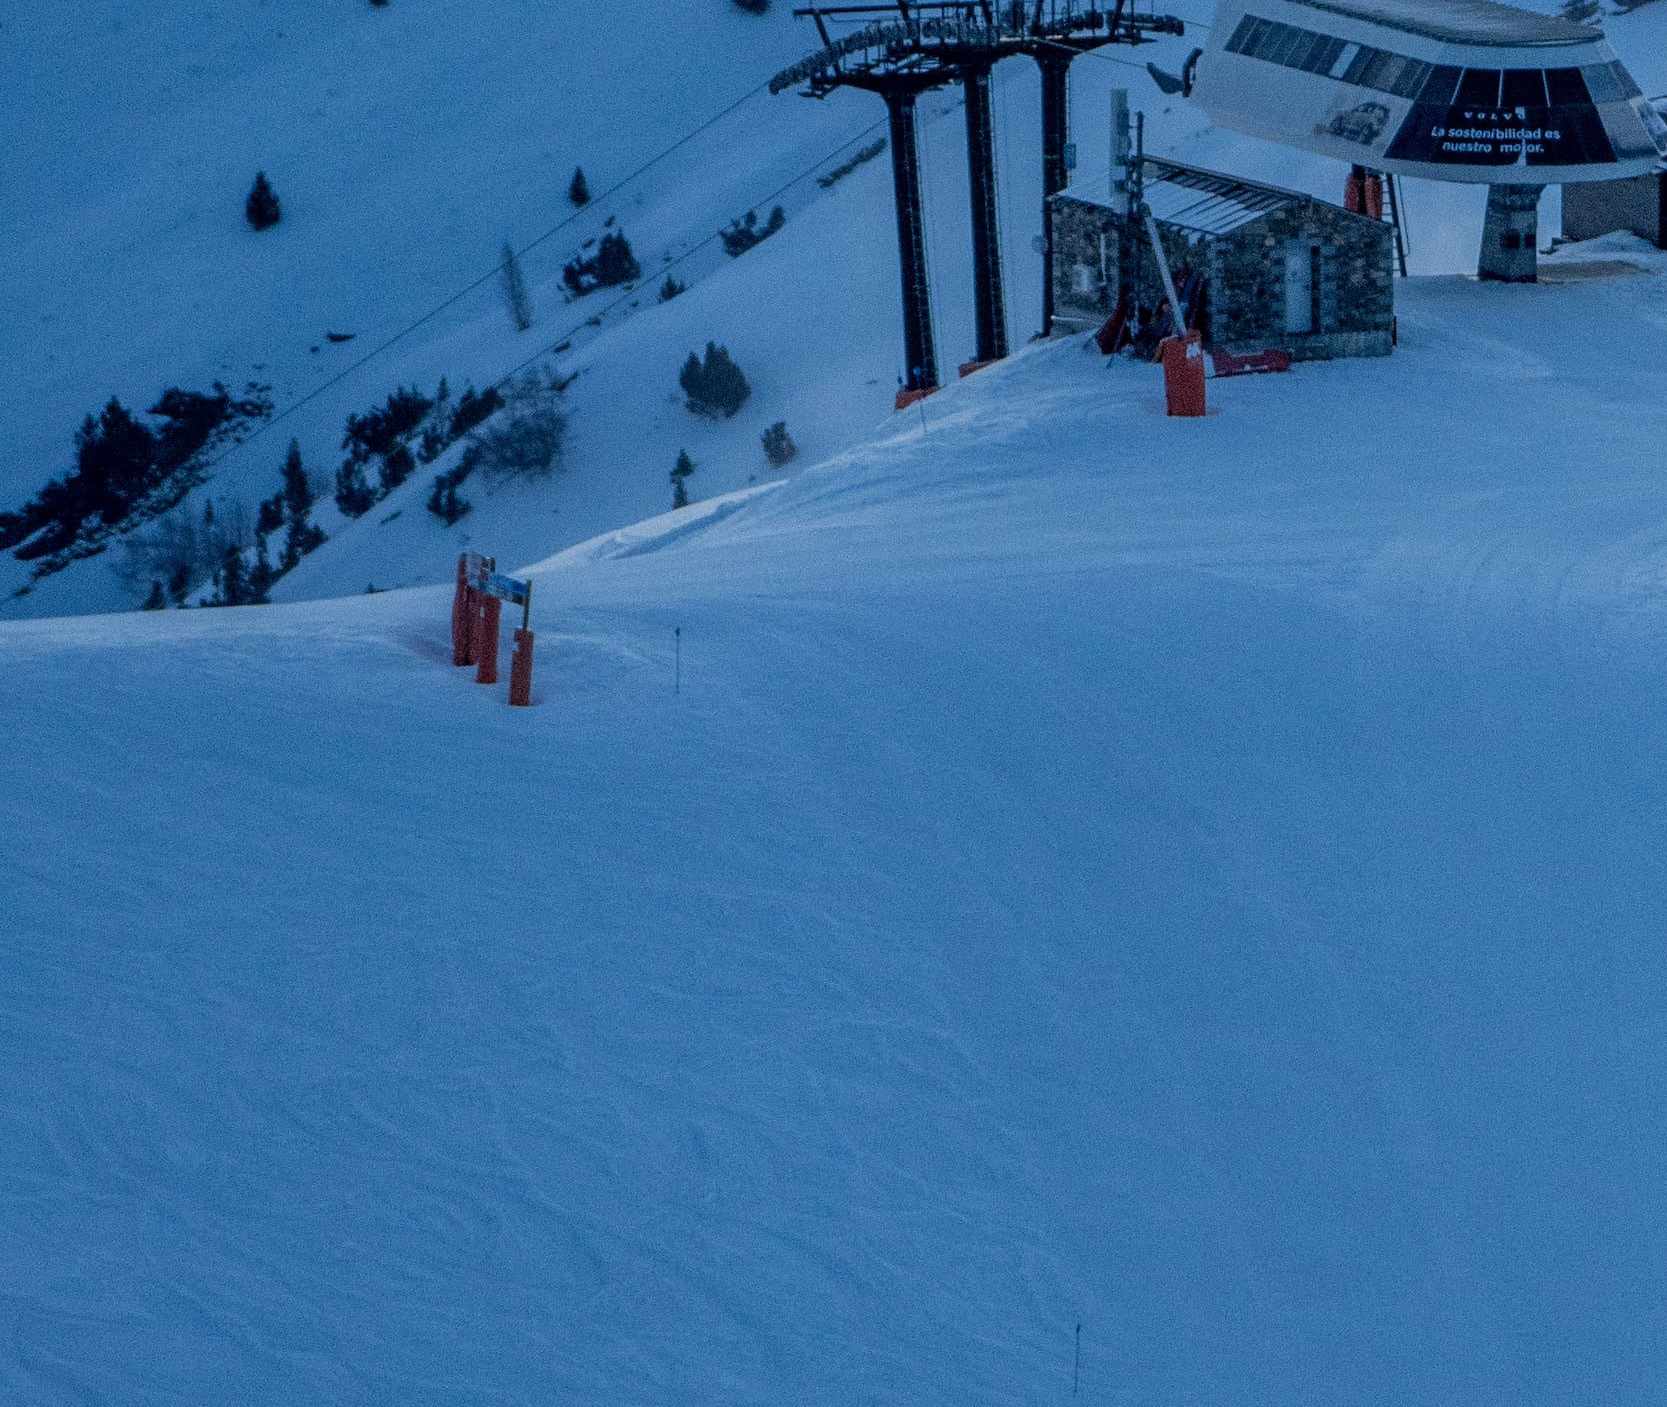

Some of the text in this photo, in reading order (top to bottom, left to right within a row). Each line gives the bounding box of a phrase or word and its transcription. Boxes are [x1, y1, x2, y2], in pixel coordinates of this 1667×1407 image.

[1431, 126, 1561, 140] La sostenibilidad es
[1442, 142, 1492, 153] nuestro
